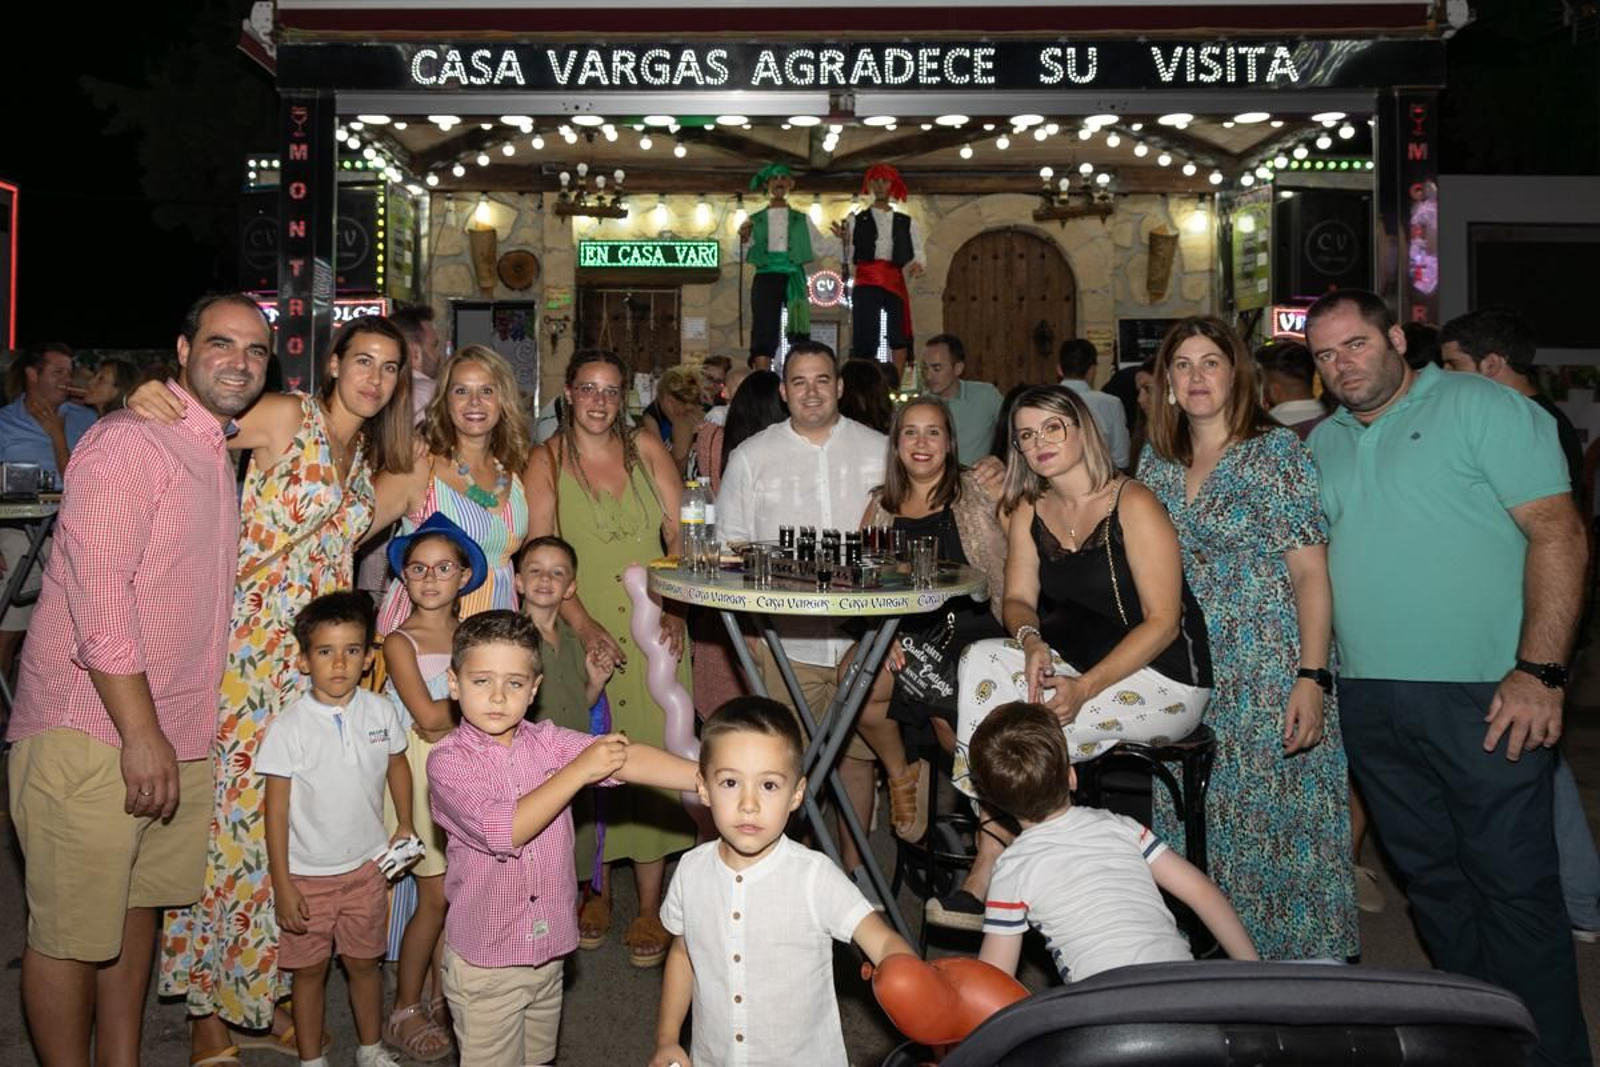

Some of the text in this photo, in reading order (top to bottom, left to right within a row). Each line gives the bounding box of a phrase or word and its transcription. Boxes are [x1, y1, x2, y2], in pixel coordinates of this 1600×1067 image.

[411, 46, 1299, 85] CASA VARGAS AGRADECE SU VISITA
[585, 246, 609, 263] EN
[618, 246, 665, 263] CASA
[816, 280, 835, 292] CV
